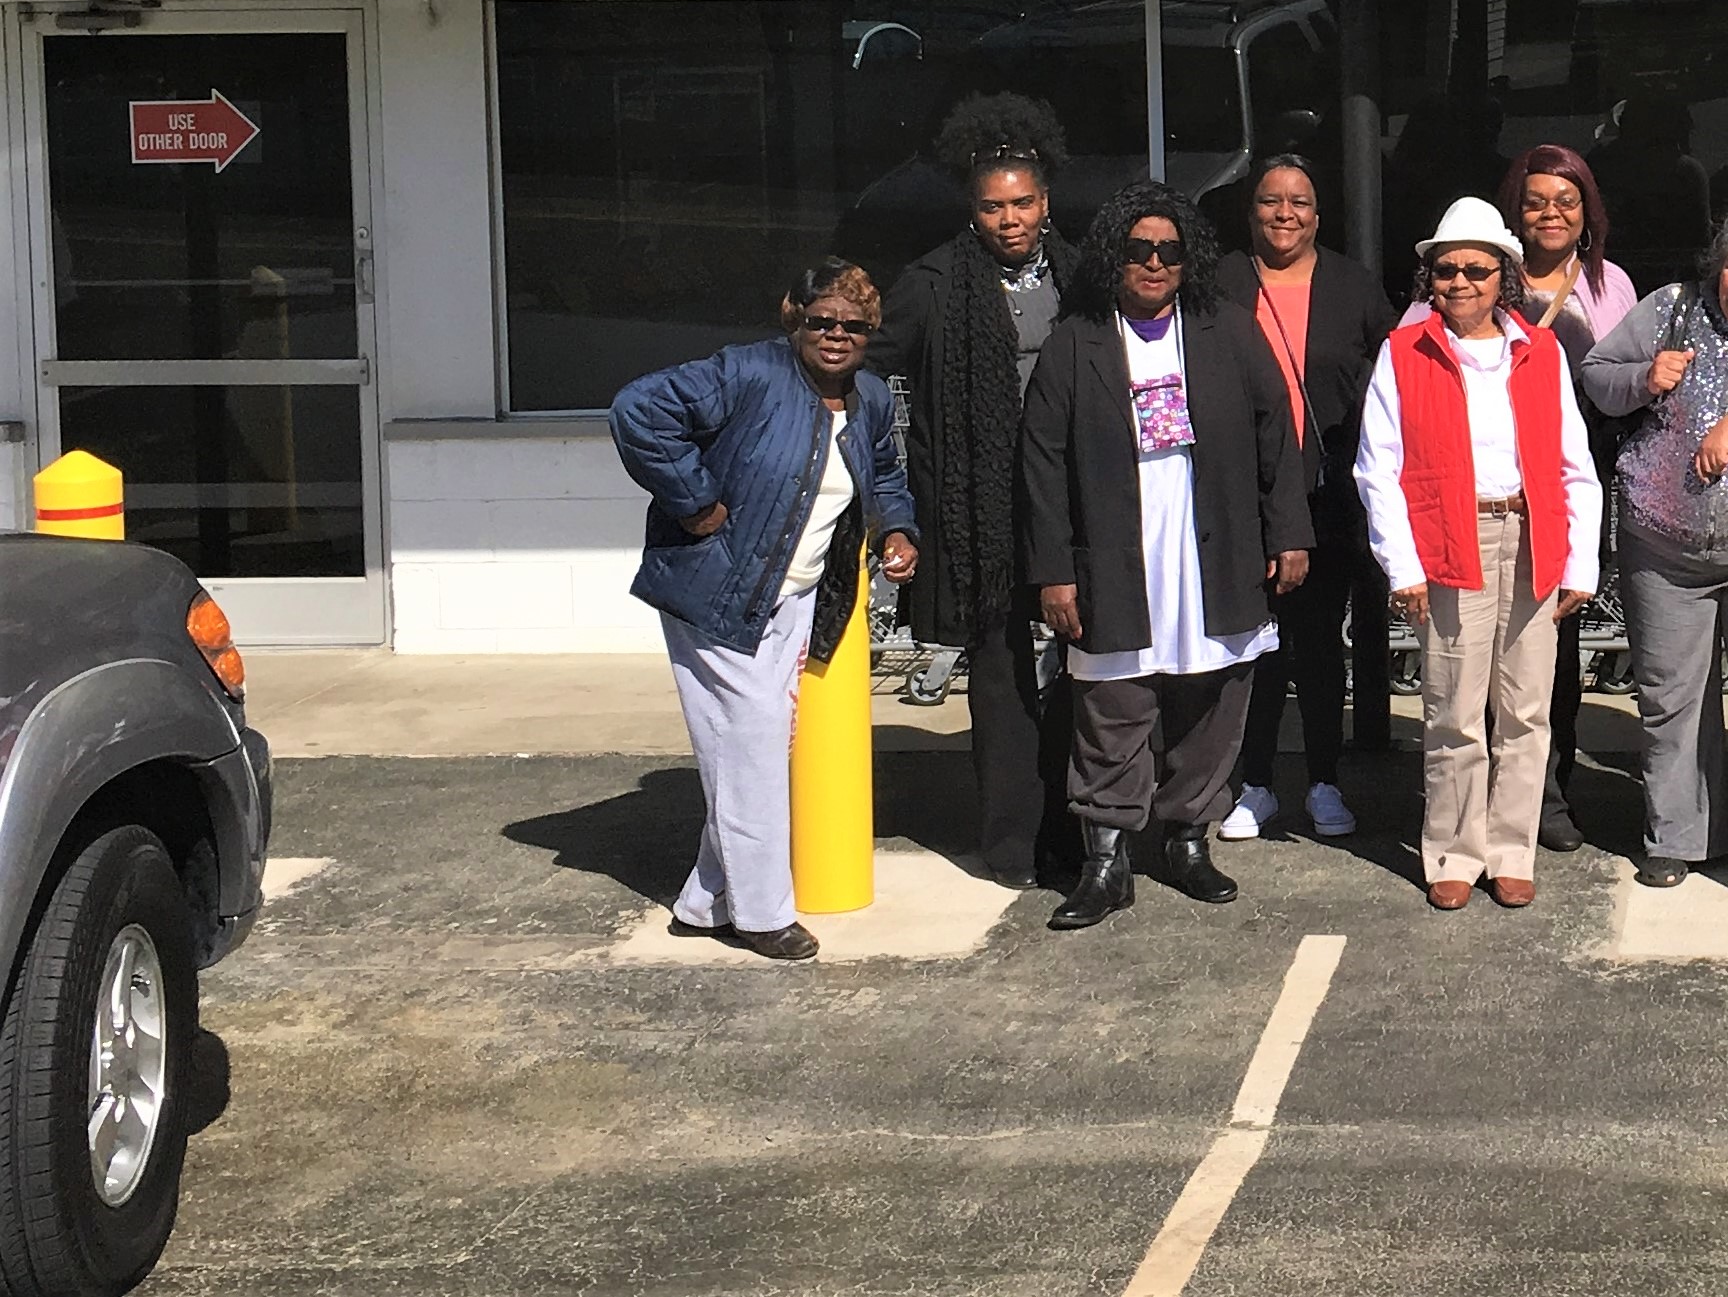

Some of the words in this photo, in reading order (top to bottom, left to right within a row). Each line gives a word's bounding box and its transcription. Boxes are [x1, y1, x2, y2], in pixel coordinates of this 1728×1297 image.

[168, 113, 196, 131] USE
[138, 133, 183, 151] OTHER
[189, 132, 228, 150] DOOR
